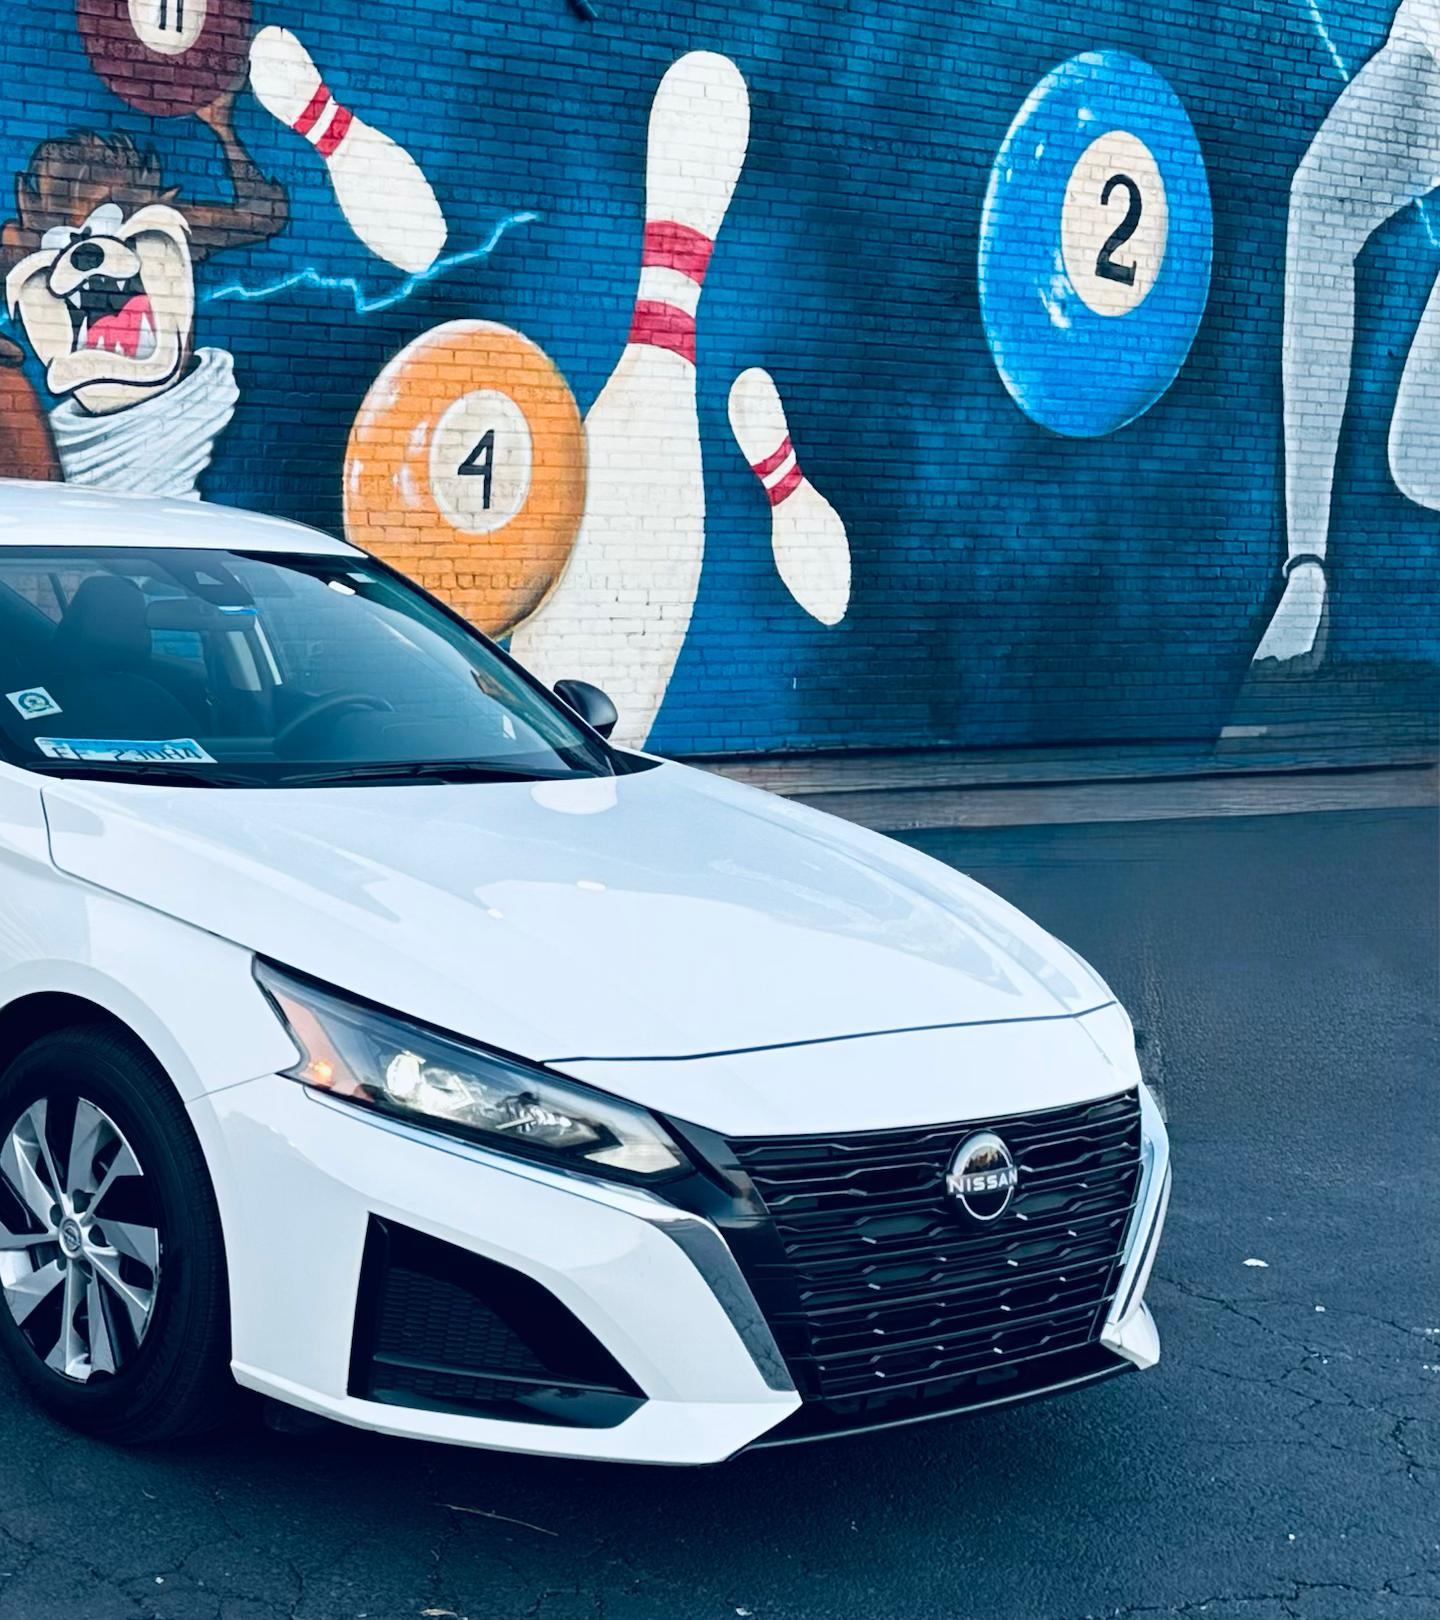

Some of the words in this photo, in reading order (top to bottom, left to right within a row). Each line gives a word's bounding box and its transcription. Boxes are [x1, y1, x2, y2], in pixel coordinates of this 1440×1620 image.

[1095, 173, 1143, 287] 2
[457, 429, 495, 510] 4
[946, 1166, 1018, 1194] NISSAN
